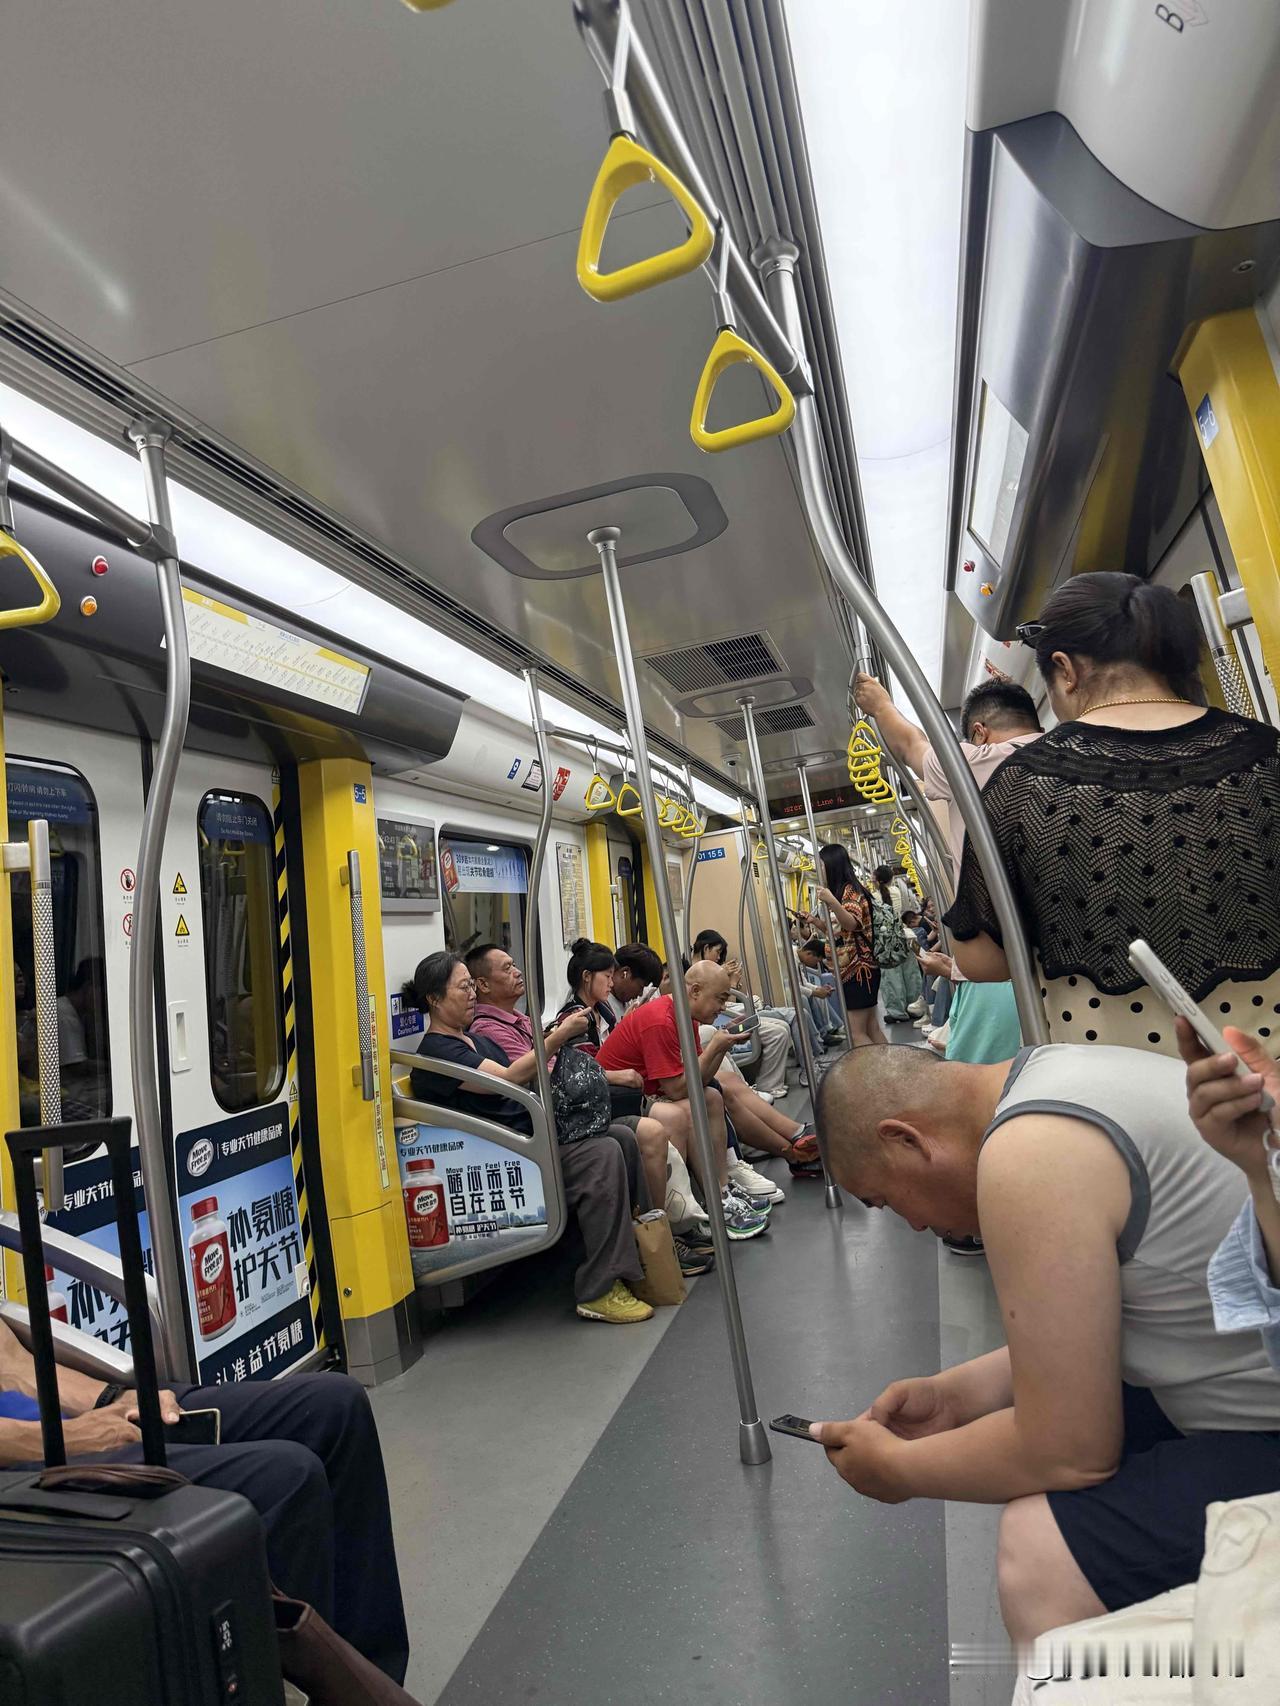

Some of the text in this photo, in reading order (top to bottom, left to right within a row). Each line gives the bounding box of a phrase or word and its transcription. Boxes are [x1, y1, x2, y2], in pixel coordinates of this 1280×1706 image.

[1155, 4, 1184, 33] B
[354, 786, 366, 800] 5-5
[221, 1123, 283, 1156] 专业关节健康品牌
[400, 1141, 465, 1157] 专业关节健康品牌
[192, 1144, 208, 1160] Move
[485, 1161, 501, 1169] Feel
[447, 1166, 523, 1194] 随心而动
[417, 1193, 433, 1204] Move
[450, 1187, 526, 1216] 自在益节
[226, 1185, 297, 1253] 补氨糖
[204, 1247, 219, 1266] Move
[233, 1231, 301, 1303] 护关节
